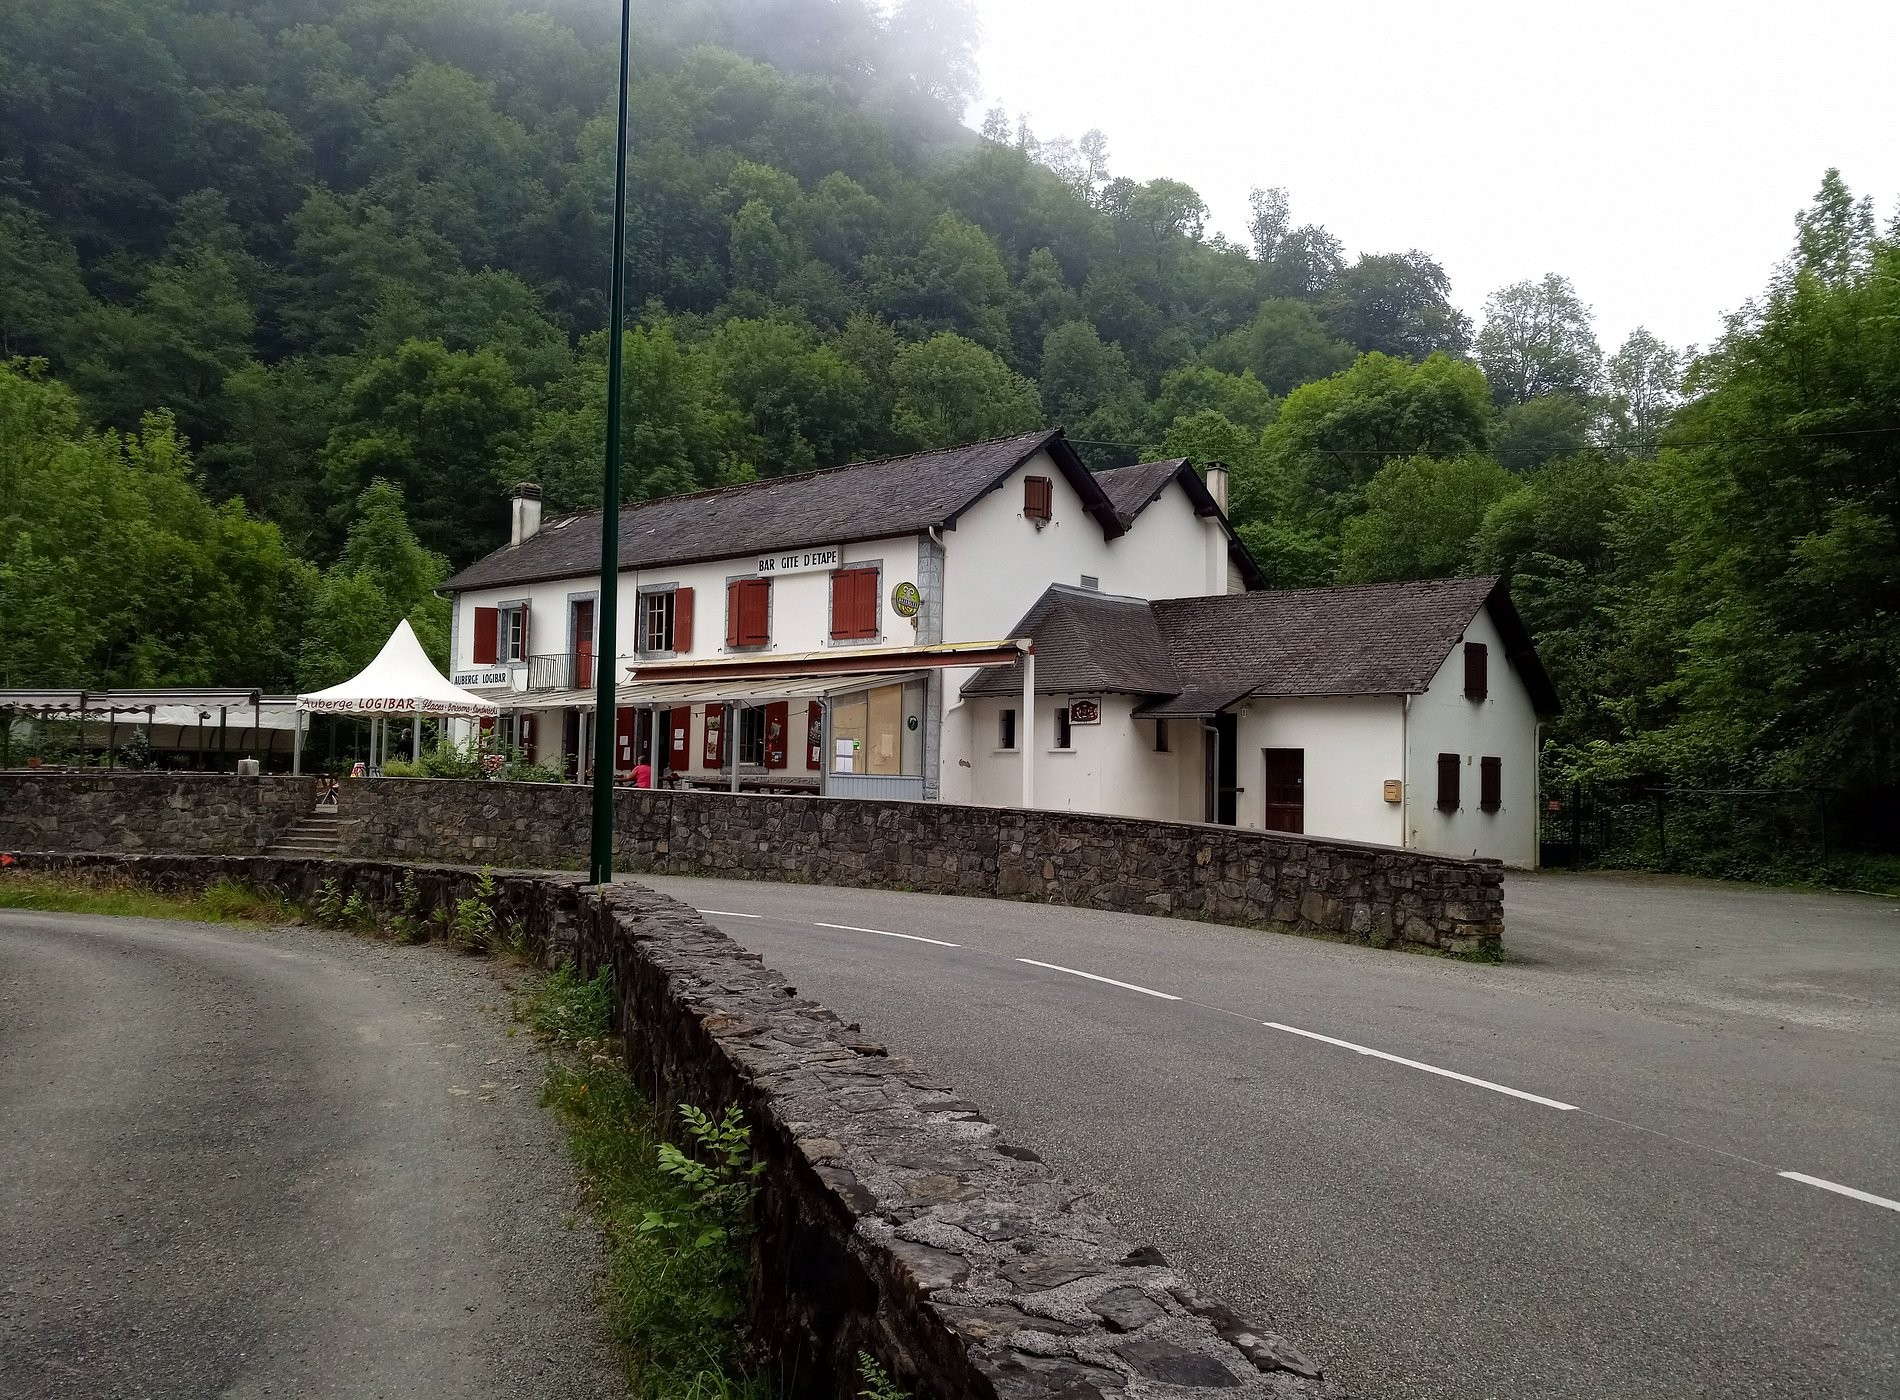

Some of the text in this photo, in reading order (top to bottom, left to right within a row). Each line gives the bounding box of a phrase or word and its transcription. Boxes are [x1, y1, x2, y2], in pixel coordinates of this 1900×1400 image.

[759, 550, 837, 572] BAR GITE D'ETAPE
[453, 672, 507, 686] AUBERGE LOGIBAR
[299, 698, 416, 711] Auberge LOGIBAR
